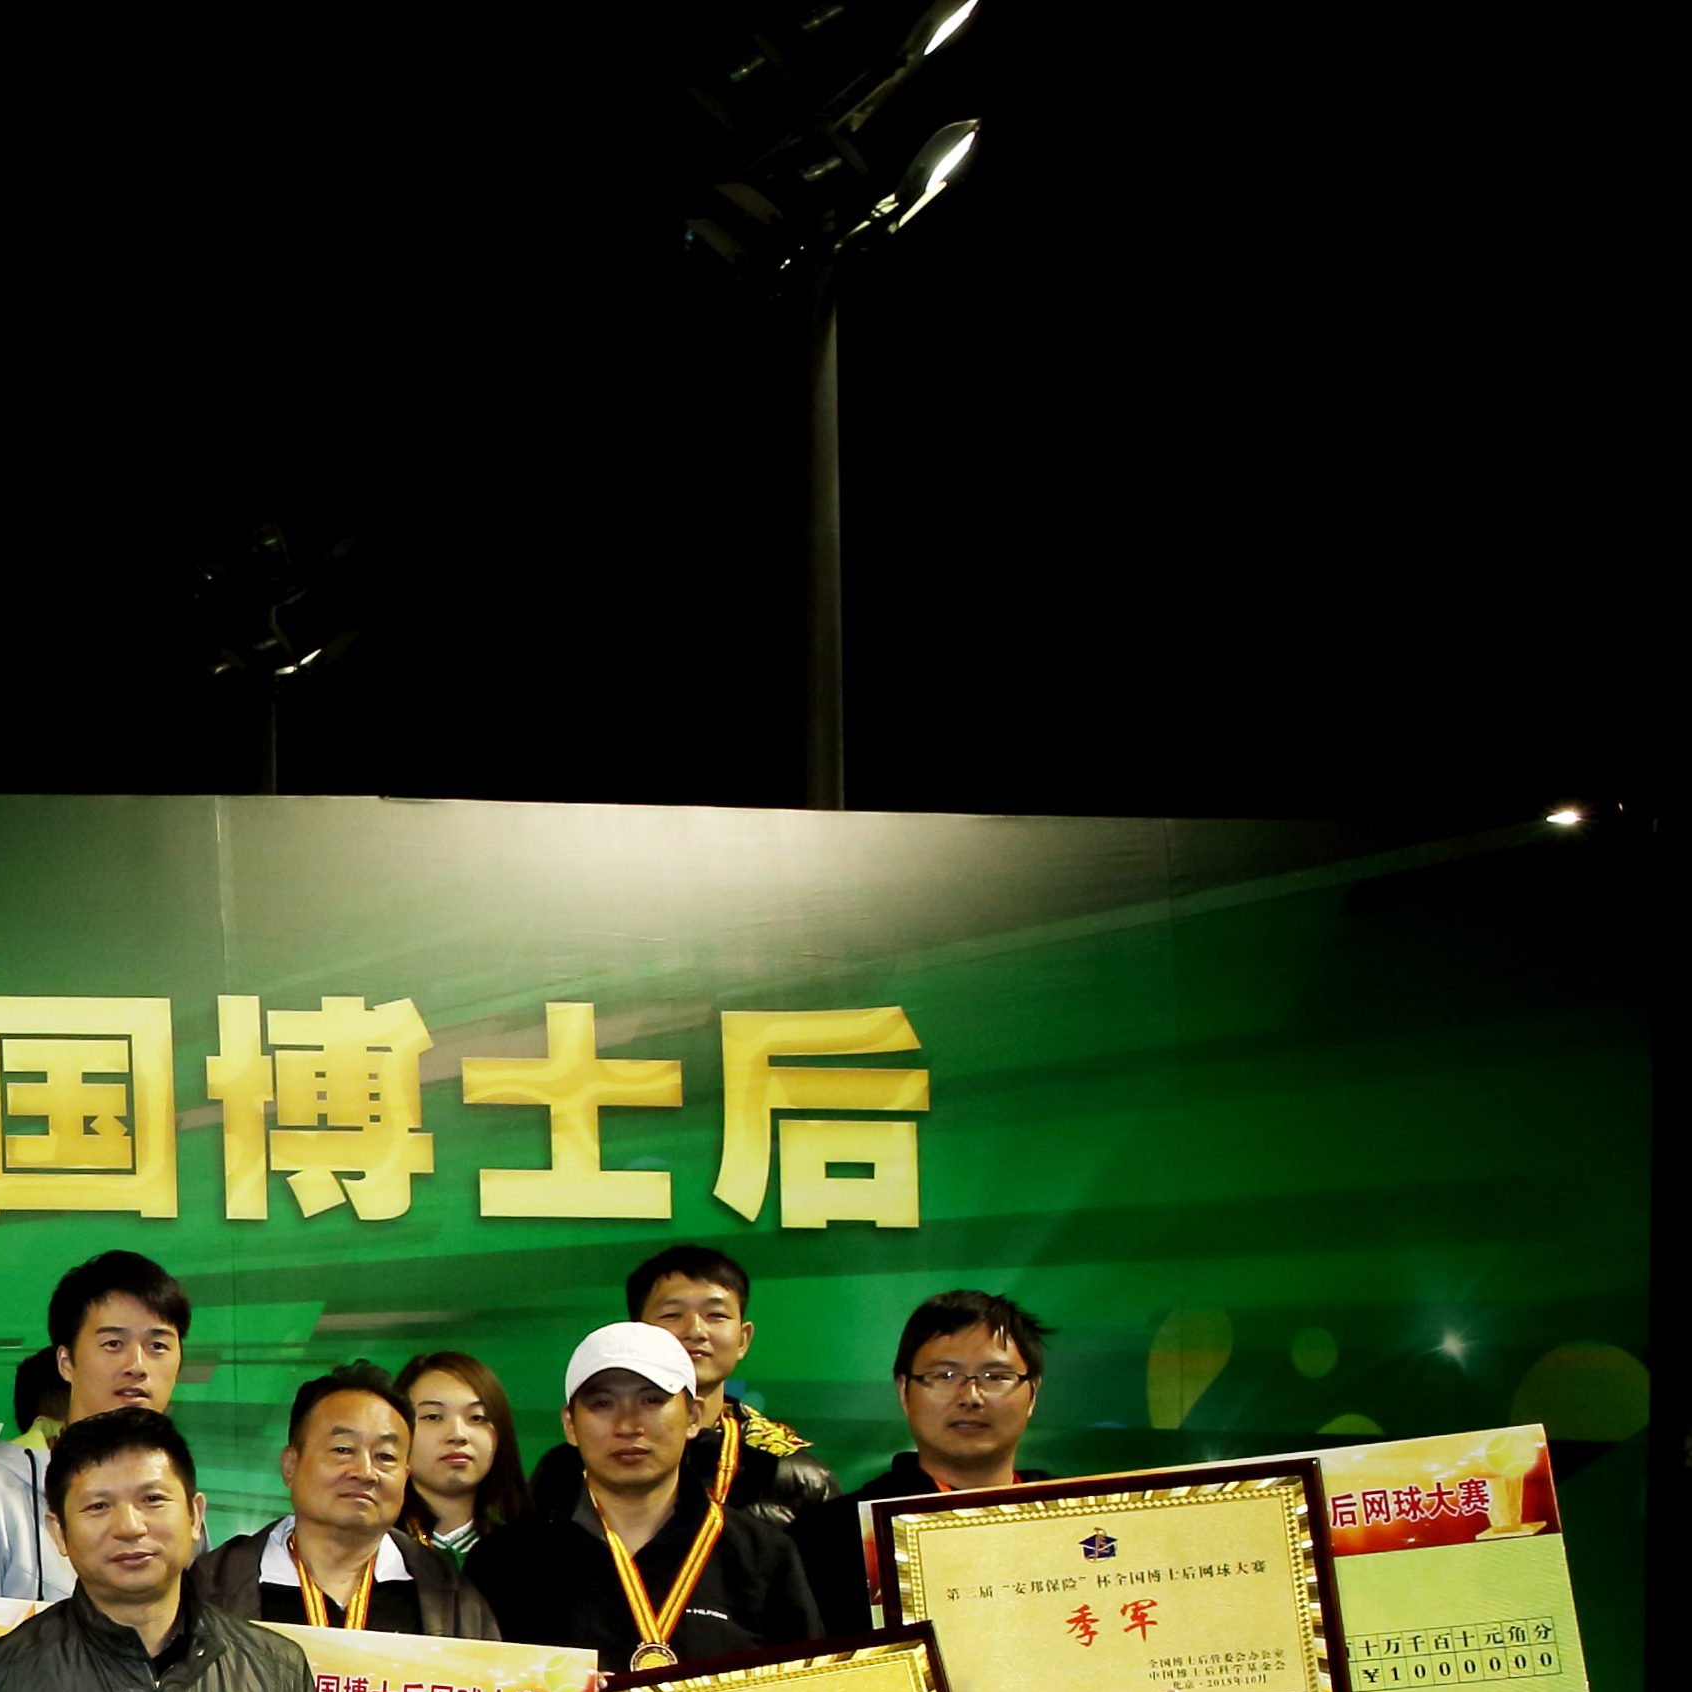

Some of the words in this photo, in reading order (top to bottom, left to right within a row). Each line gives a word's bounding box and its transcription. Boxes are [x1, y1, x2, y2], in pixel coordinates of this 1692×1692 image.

[1330, 1478, 1490, 1528] 后网球大赛
[1065, 1599, 1158, 1646] 季军
[1346, 1623, 1552, 1658] 十万千百十元角分
